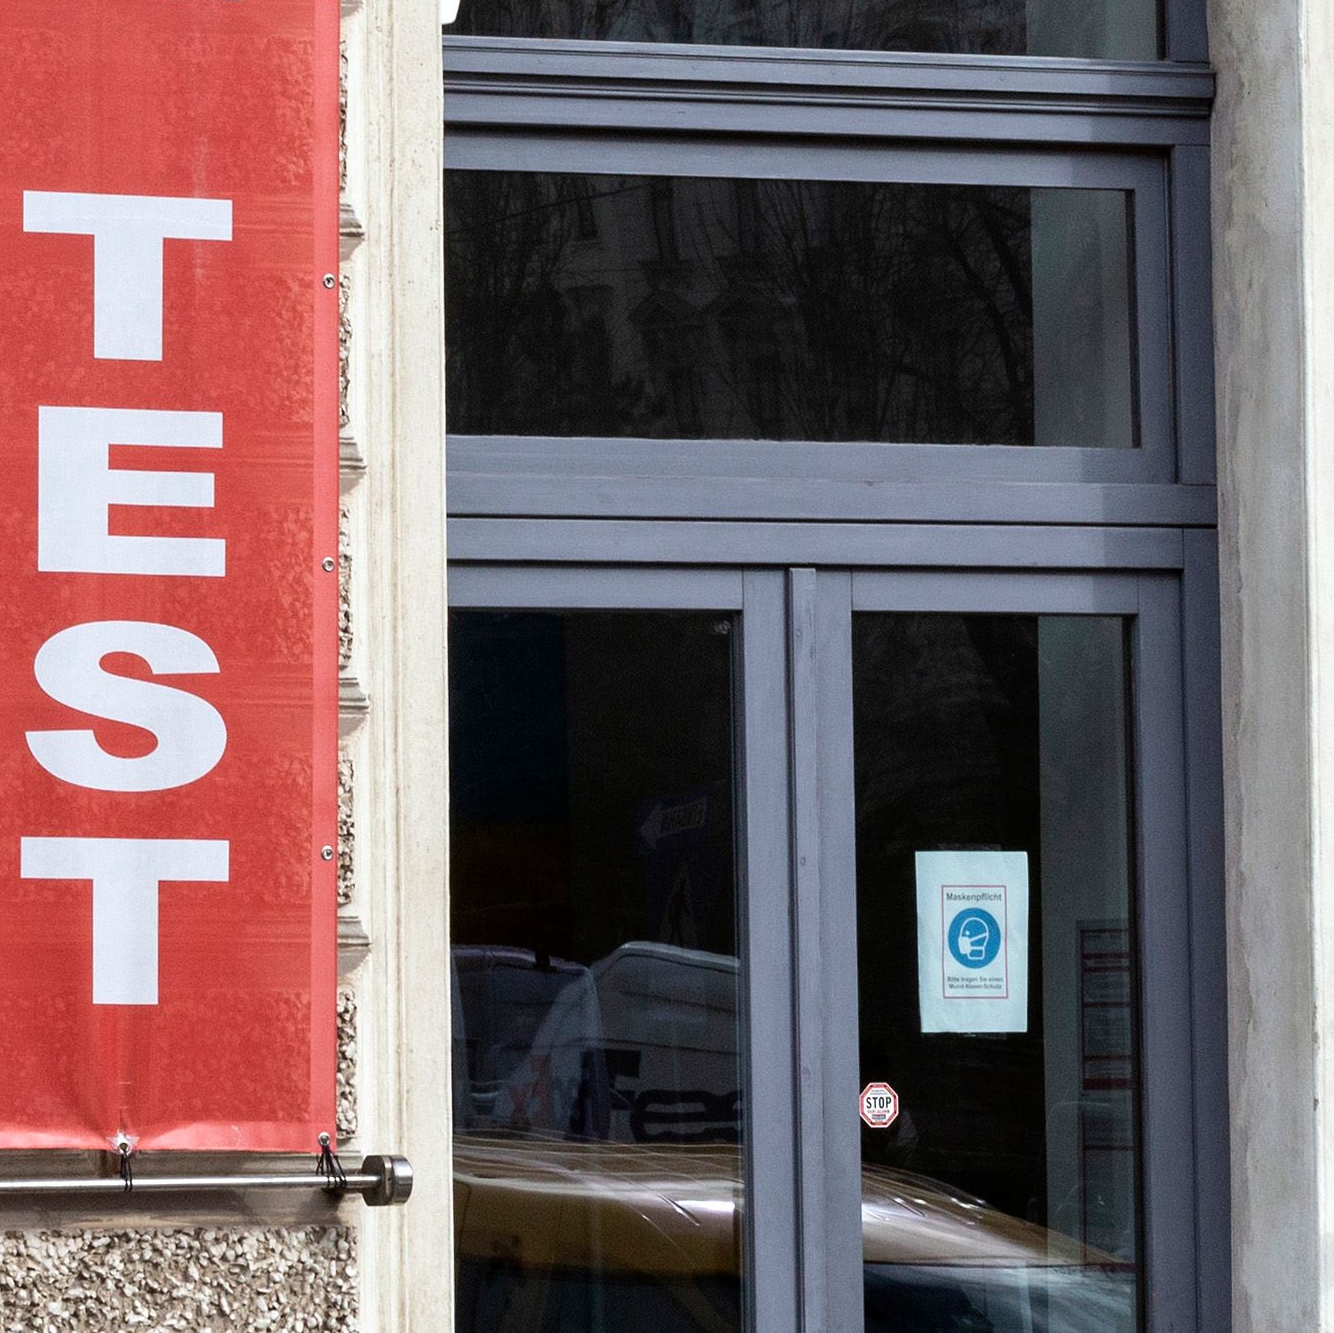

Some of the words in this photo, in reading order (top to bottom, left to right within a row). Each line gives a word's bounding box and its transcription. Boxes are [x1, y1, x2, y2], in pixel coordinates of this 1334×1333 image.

[20, 190, 233, 1006] TEST
[946, 892, 1002, 902] Maskenpflicht
[866, 1097, 892, 1109] STOP
